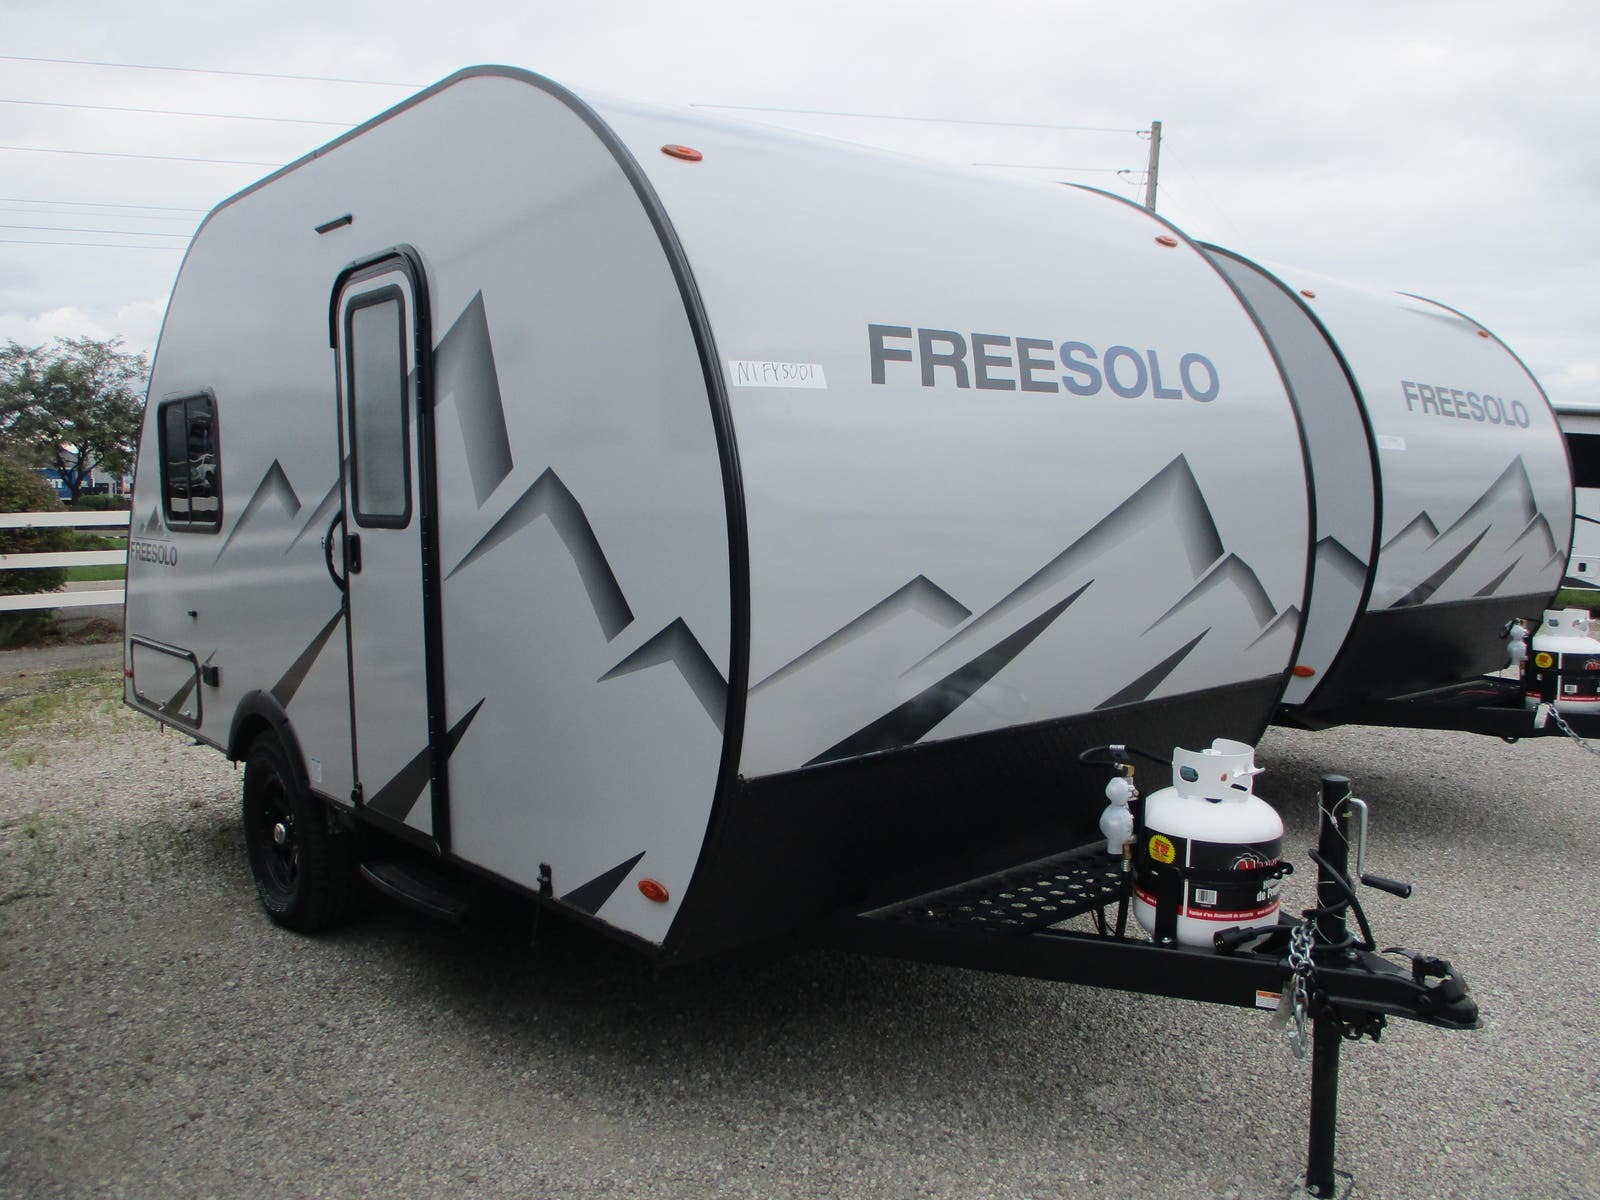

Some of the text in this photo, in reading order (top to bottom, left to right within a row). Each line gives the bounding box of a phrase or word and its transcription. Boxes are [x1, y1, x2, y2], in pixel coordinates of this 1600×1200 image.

[868, 323, 1220, 403] FREESOLO
[1400, 380, 1530, 429] FREESOLO
[130, 541, 178, 567] FREESOLO
